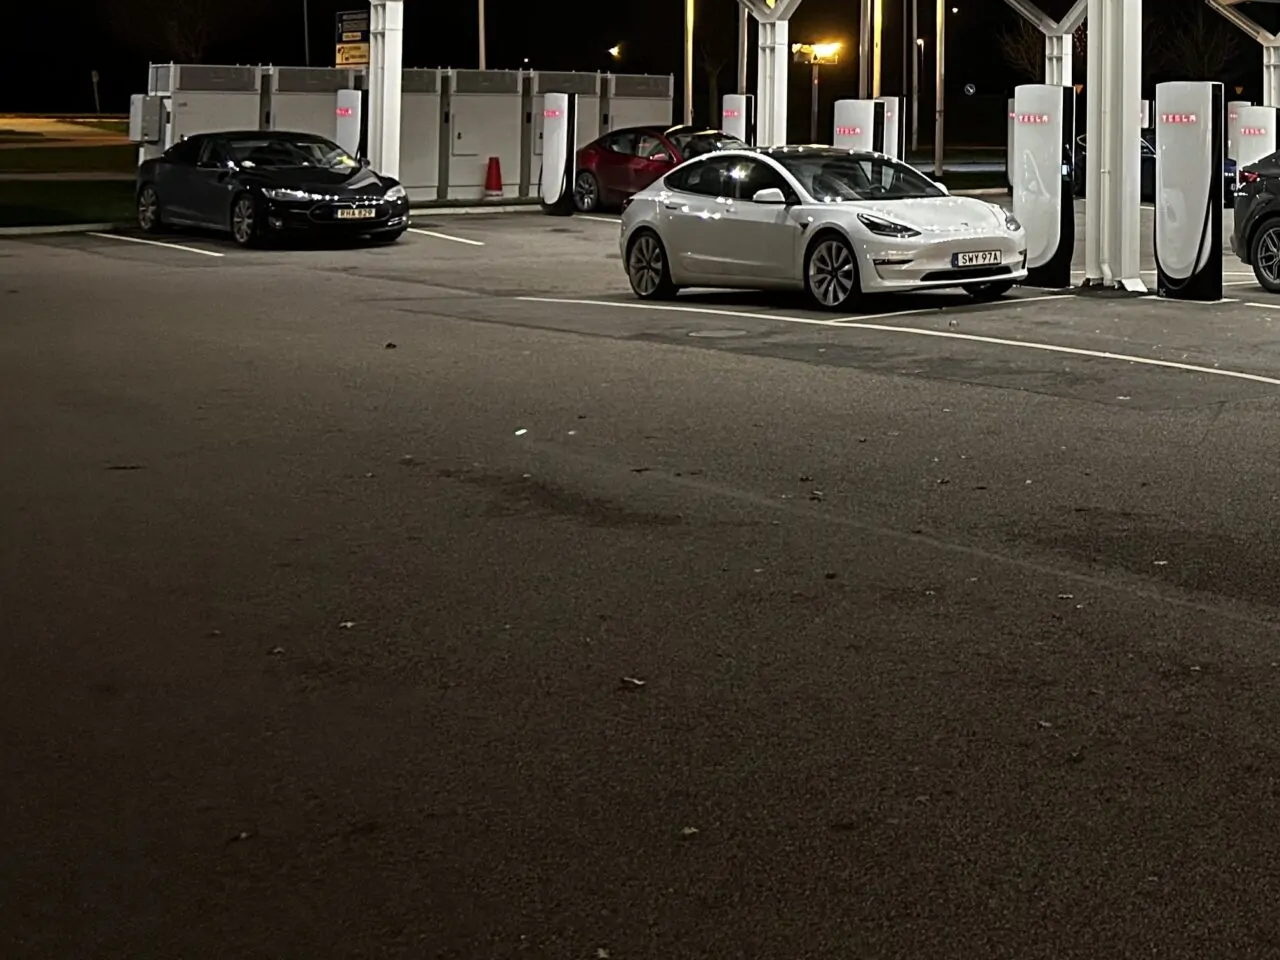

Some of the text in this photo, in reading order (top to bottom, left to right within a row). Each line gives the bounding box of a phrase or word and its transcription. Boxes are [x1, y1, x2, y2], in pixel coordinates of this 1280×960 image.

[1019, 115, 1049, 123] TESLA
[1161, 114, 1197, 123] TESLA
[961, 252, 998, 265] SWY 97A
